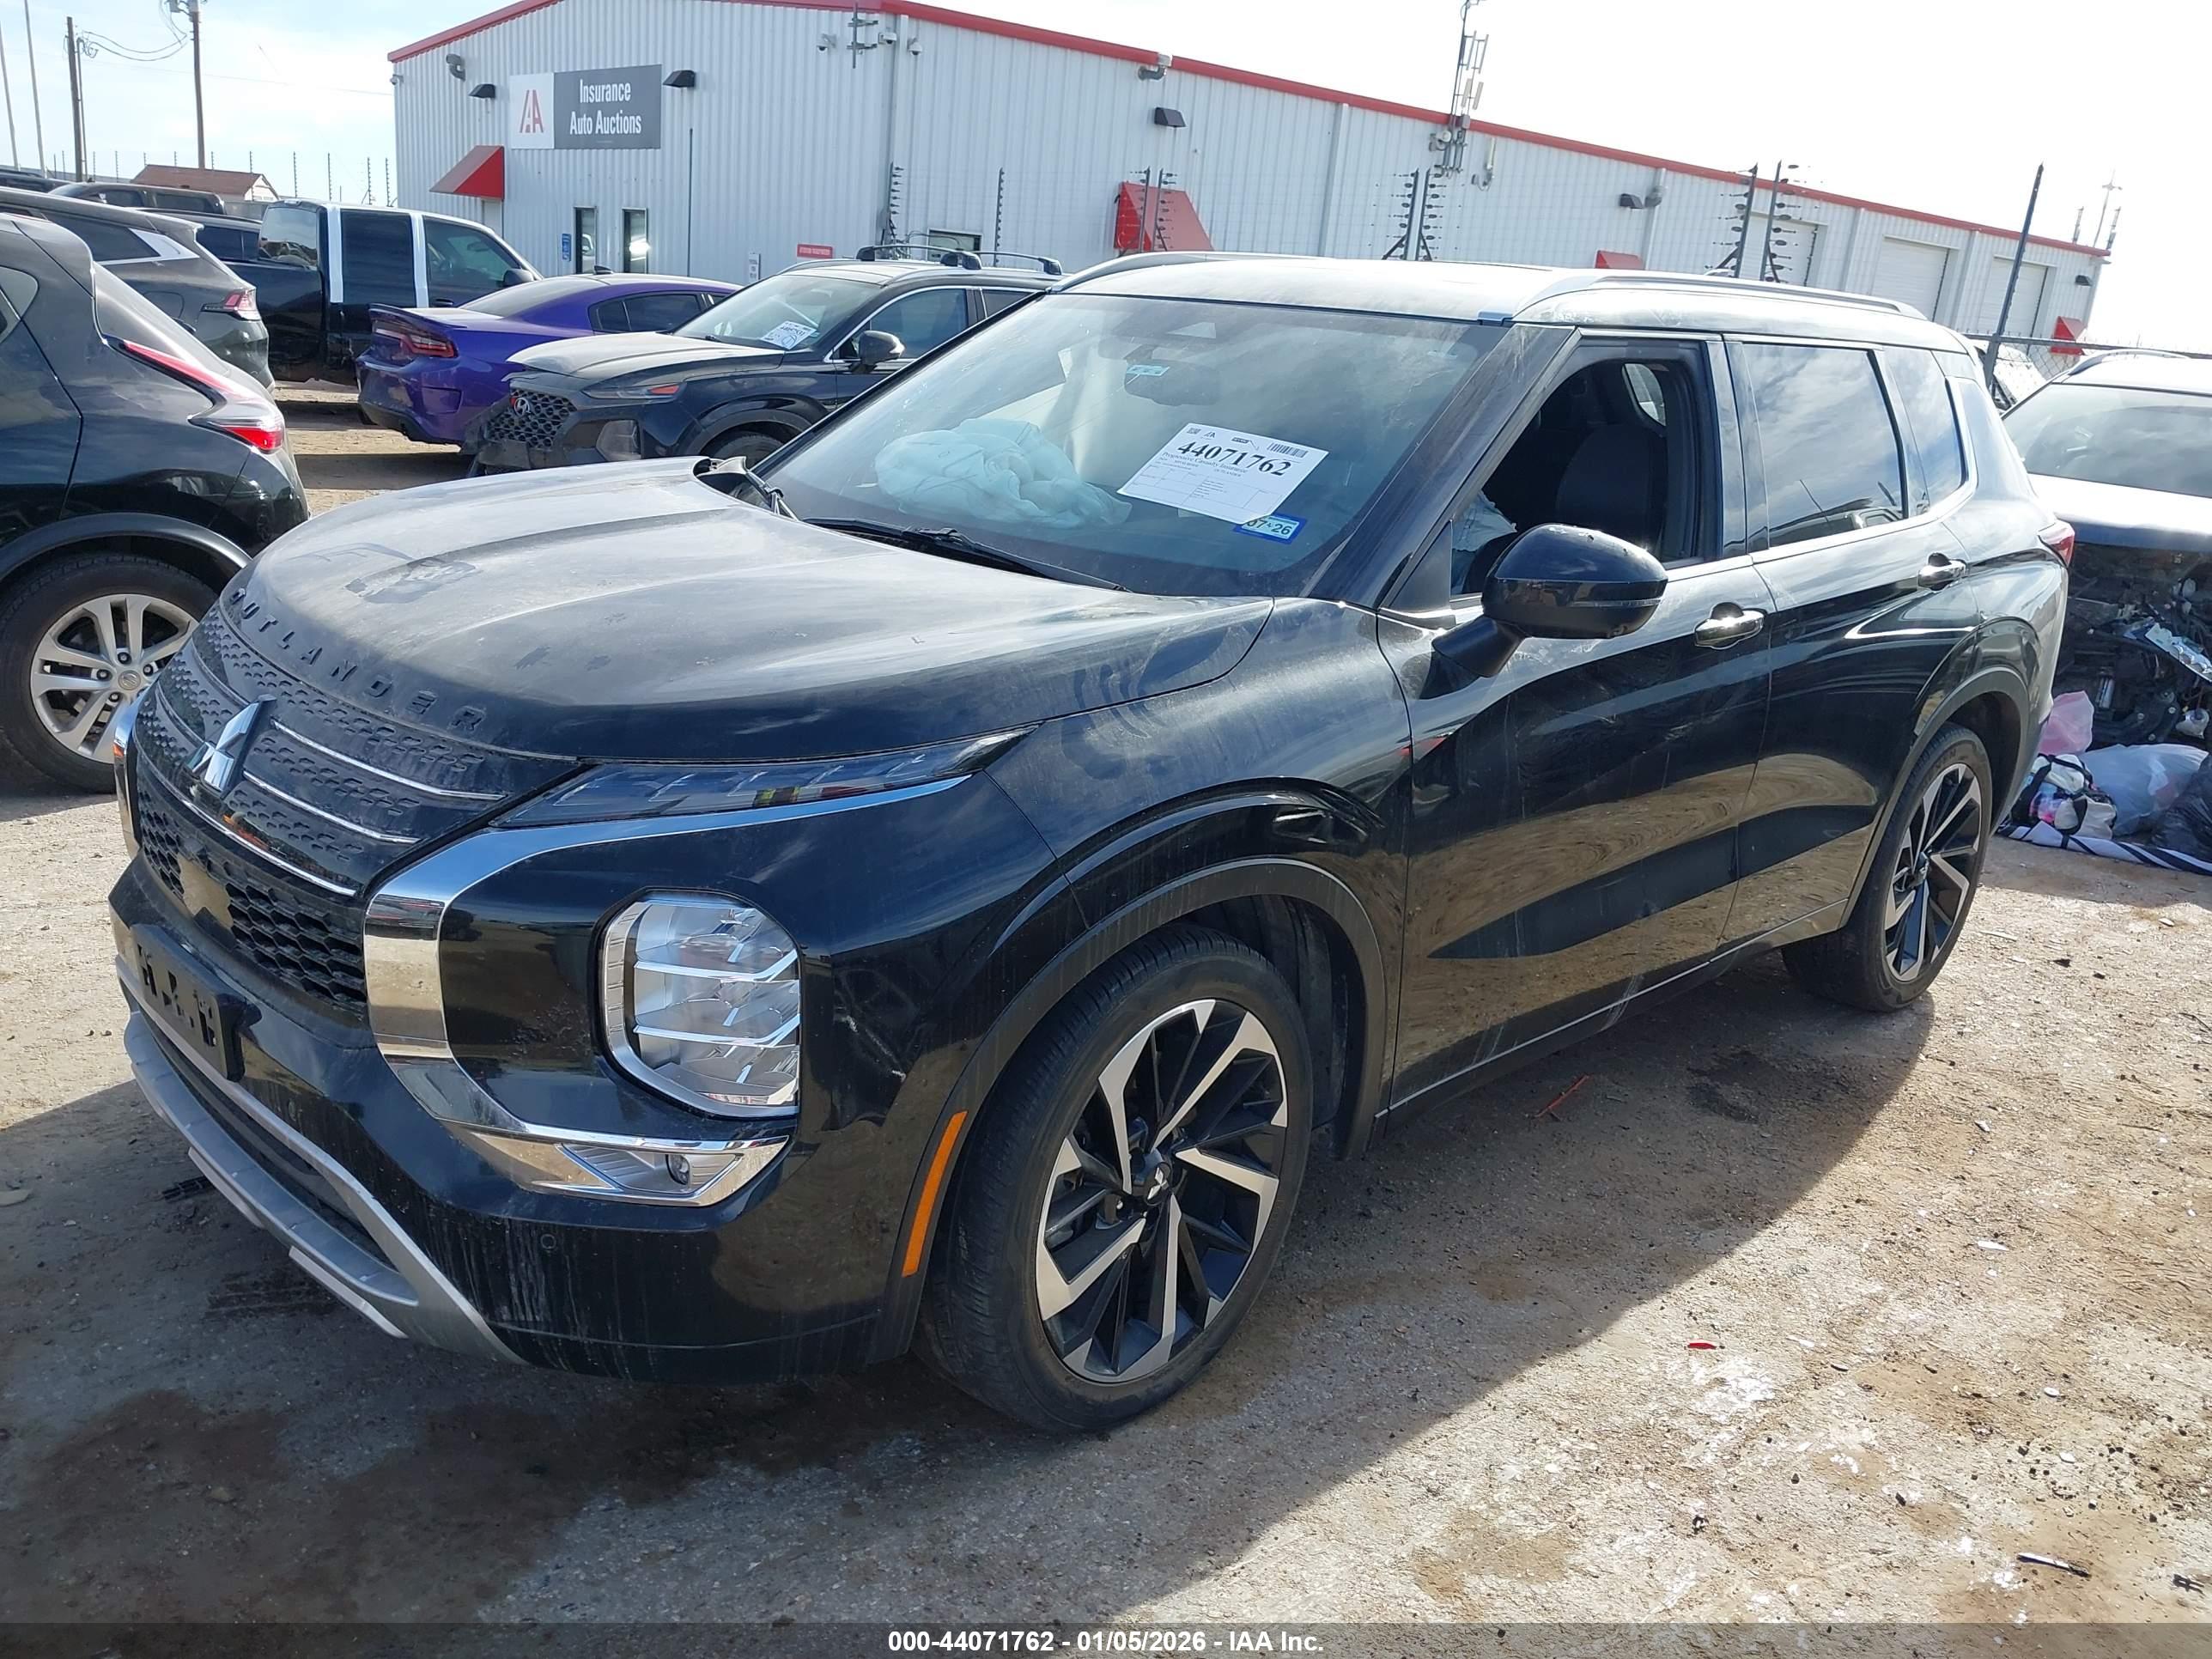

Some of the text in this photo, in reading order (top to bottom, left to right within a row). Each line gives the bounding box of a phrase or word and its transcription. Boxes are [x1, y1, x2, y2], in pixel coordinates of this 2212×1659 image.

[580, 79, 631, 104] Insurance
[569, 109, 642, 135] Auto Auctions
[1177, 441, 1292, 476] 44071762
[1271, 524, 1293, 535] 26
[229, 588, 487, 732] OUTLANDER
